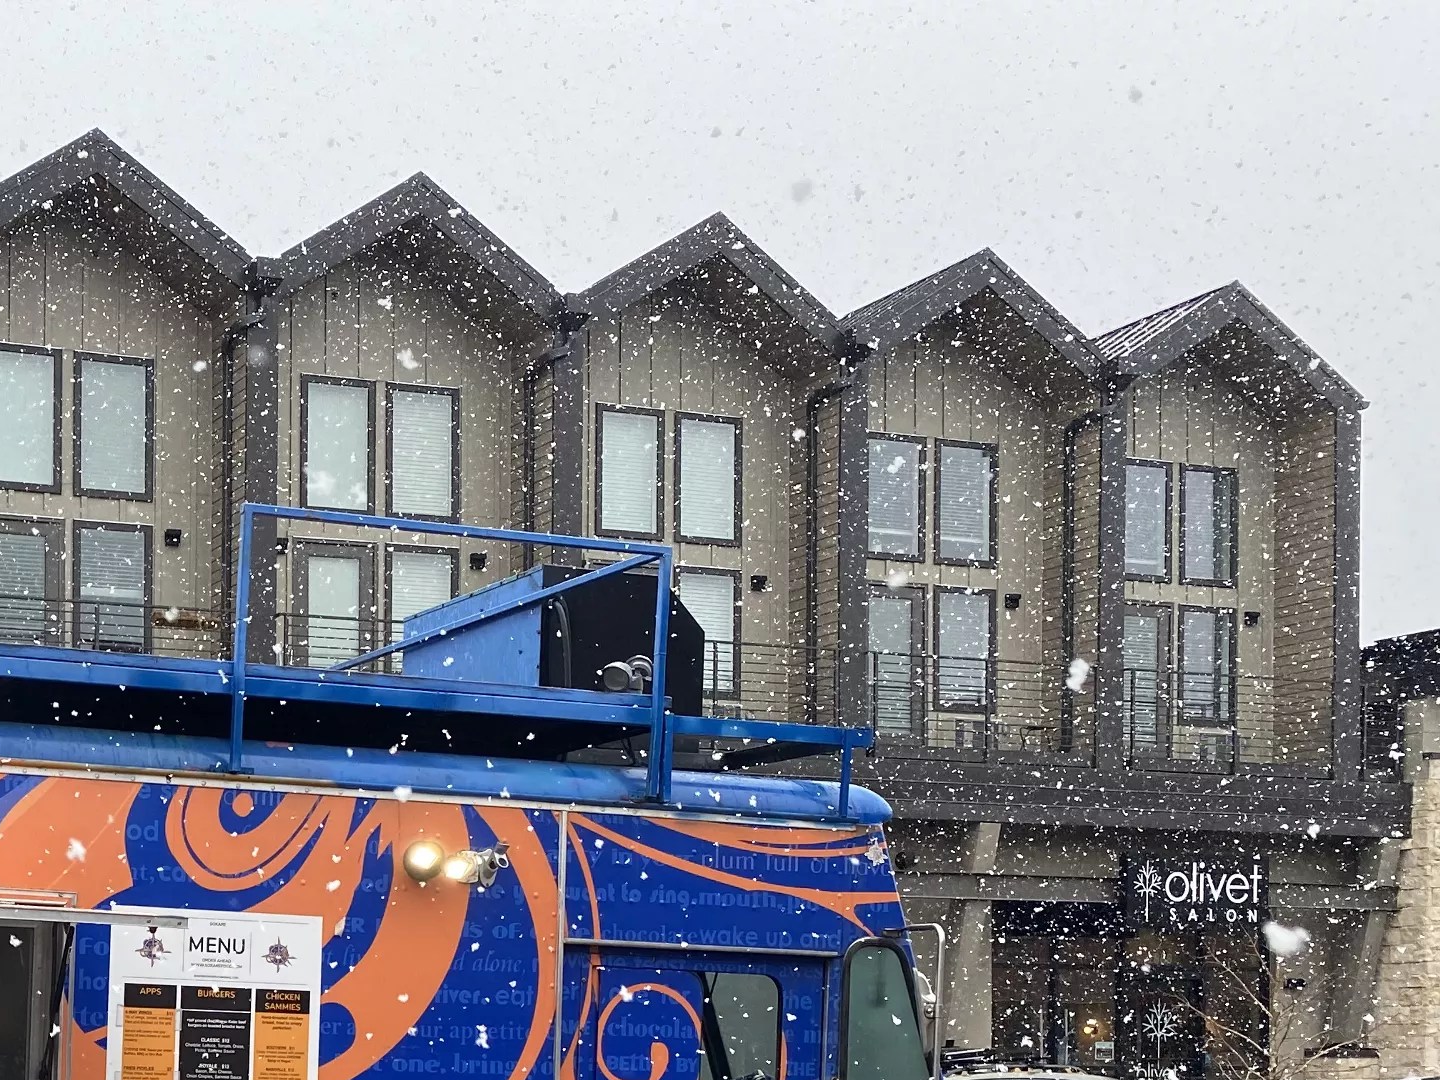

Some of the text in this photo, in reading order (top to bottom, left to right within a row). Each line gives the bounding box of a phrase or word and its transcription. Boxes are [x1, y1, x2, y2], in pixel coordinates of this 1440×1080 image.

[1165, 861, 1262, 904] olivet
[1169, 907, 1258, 922] SALON
[699, 926, 758, 945] wake
[189, 936, 245, 954] MENU
[140, 987, 162, 995] APPS
[197, 989, 236, 998] BURGERS
[265, 992, 301, 1001] CHICKEN
[264, 1002, 301, 1011] SAMMIES
